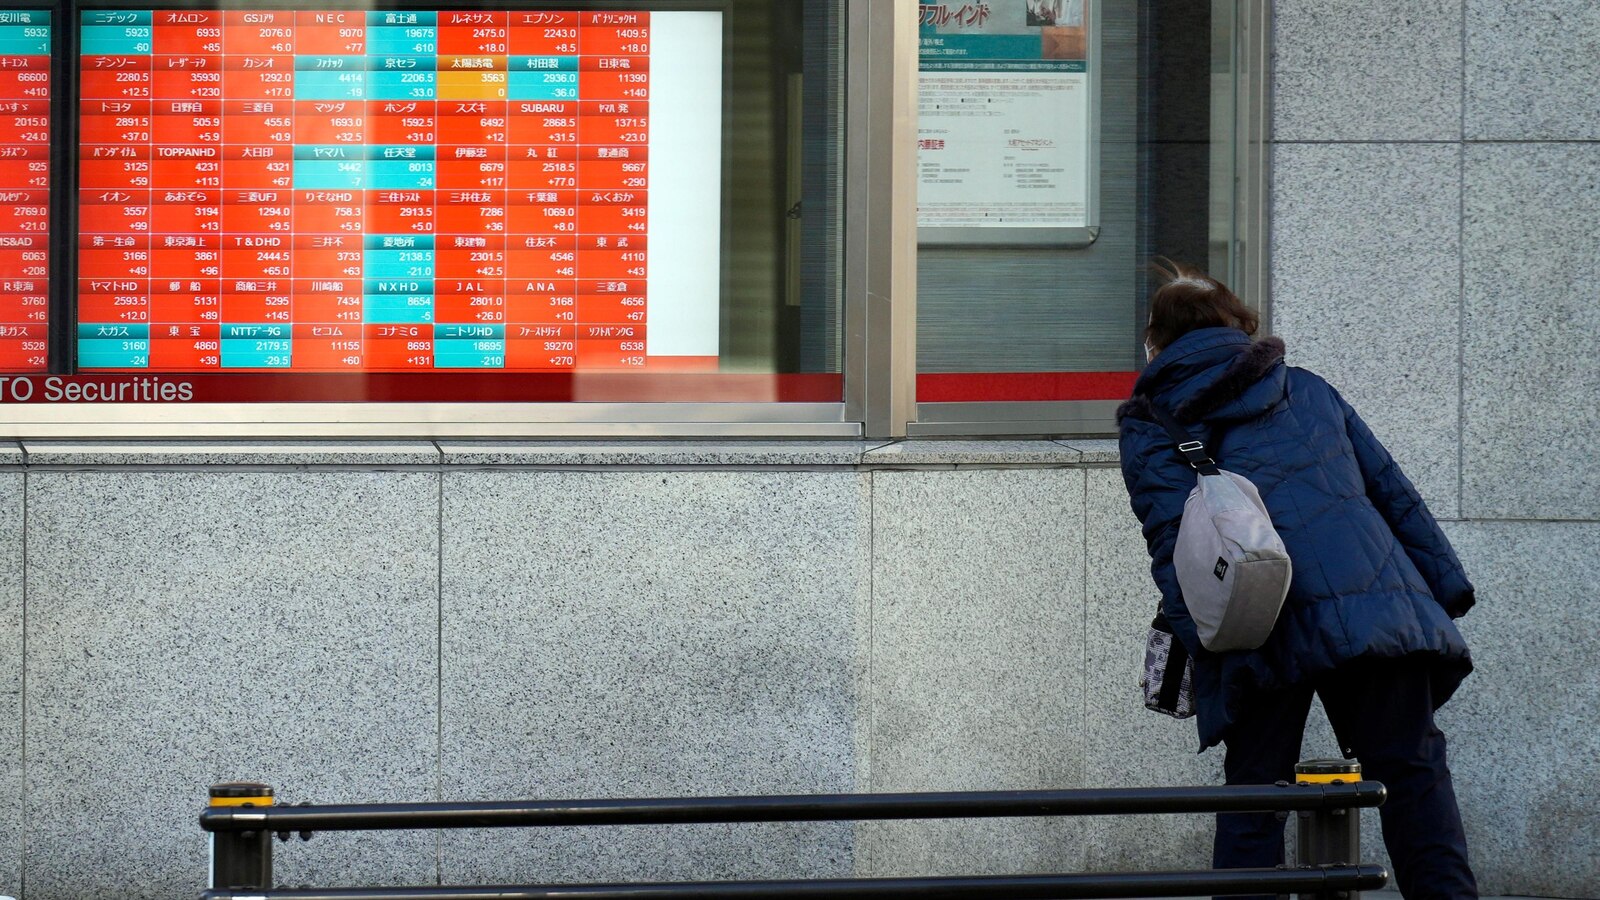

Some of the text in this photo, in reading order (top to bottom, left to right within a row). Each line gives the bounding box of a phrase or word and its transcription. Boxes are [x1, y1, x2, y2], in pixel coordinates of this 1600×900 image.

[95, 12, 138, 23] ニデック
[167, 12, 209, 23] オムロン
[384, 12, 418, 24] 富士通
[451, 13, 494, 24] ルネサス
[522, 12, 565, 24] エプソン
[24, 27, 48, 38] 5932
[125, 27, 150, 38] 5923
[196, 28, 221, 38] 6933
[259, 28, 292, 38] 2076.0
[338, 28, 363, 38] 9070
[404, 28, 435, 38] 19675
[472, 28, 506, 38] 2475.0
[543, 28, 577, 38] 2243.0
[615, 28, 648, 39] 1409.5
[477, 43, 506, 53] +18.0
[620, 43, 648, 53] +18.0
[95, 56, 137, 68] デンソー
[242, 57, 275, 68] カシオ
[384, 58, 417, 69] 京セラ
[450, 57, 494, 69] 太陽誘電
[526, 57, 559, 69] 村田製
[598, 57, 631, 69] 日東電
[17, 72, 48, 82] 66600
[116, 72, 149, 82] 2280.5
[190, 72, 221, 82] 35930
[259, 72, 292, 83] 1292.0
[400, 72, 434, 83] 2206.5
[480, 72, 506, 83] 3563
[542, 72, 577, 83] 2936.0
[618, 73, 647, 83] 11390
[121, 87, 149, 97] +12.5
[190, 87, 221, 97] +1230
[264, 87, 292, 97] +17.0
[407, 87, 434, 97] -33.0
[550, 87, 577, 98] -36.0
[101, 102, 132, 113] トヨタ
[171, 101, 203, 113] 日野自
[241, 102, 274, 113] 三菱自
[314, 102, 346, 113] マツダ
[384, 102, 417, 113] ホンダ
[455, 102, 488, 113] スズキ
[520, 103, 565, 113] SUBARU
[14, 117, 48, 127] 2015.0
[115, 117, 149, 127] 2891.5
[192, 117, 221, 127] 505.9
[263, 117, 292, 127] 455.6
[330, 117, 363, 127] 1693.0
[401, 117, 434, 127] 1592.5
[479, 117, 505, 128] 6492
[542, 117, 576, 128] 2868.5
[614, 118, 647, 128] 1371.5
[19, 132, 48, 142] +24.0
[120, 131, 149, 141] +37.0
[334, 132, 363, 142] +32.5
[405, 132, 434, 142] +31.0
[548, 132, 576, 142] +31.5
[618, 132, 647, 142] +23.0
[157, 147, 216, 157] TOPPANHD
[241, 147, 274, 158] 大日印
[312, 147, 346, 158] ヤマハ
[383, 147, 417, 158] 任天堂
[454, 147, 487, 158] 伊藤忠
[596, 147, 630, 159] 豊通商
[28, 162, 48, 172] 925
[124, 161, 149, 172] 3125
[194, 162, 219, 172] 4231
[265, 162, 290, 172] 4321
[407, 162, 433, 172] 8013
[479, 162, 505, 172] 6679
[542, 162, 576, 172] 2518.5
[622, 162, 647, 172] 9667
[194, 176, 220, 186] +113
[547, 177, 576, 187] +77.0
[98, 191, 131, 202] イオン
[164, 191, 208, 202] あおぞら
[238, 192, 277, 203] 三菱UFJ
[305, 191, 353, 203] りそなHD
[449, 192, 492, 203] 三井住友
[526, 192, 558, 203] 千葉銀
[591, 192, 635, 203] ふくおか
[13, 206, 47, 216] 2769.0
[123, 206, 148, 216] 3557
[194, 206, 219, 216] 3194
[257, 207, 291, 217] 1294.0
[334, 207, 362, 217] 758.3
[399, 207, 433, 217] 2913.5
[479, 207, 504, 217] 7286
[542, 207, 575, 217] 1069.0
[621, 207, 646, 217] 3419
[19, 221, 47, 231] +21.0
[92, 235, 136, 247] 第一生命
[164, 235, 207, 247] 東京海上
[312, 236, 344, 248] 三井不
[383, 236, 415, 248] 菱地所
[453, 236, 486, 248] 東建物
[524, 236, 557, 248] 住友不
[21, 251, 47, 261] 6063
[122, 251, 148, 261] 3166
[194, 251, 218, 261] 3861
[256, 251, 290, 261] 2444.5
[336, 251, 361, 261] 3733
[398, 252, 432, 262] 2138.5
[469, 252, 504, 262] 2301.5
[549, 252, 574, 262] 4546
[620, 252, 646, 262] 4110
[261, 266, 290, 276] +65.0
[475, 266, 503, 276] +42.5
[90, 280, 138, 291] ヤマトHD
[235, 280, 277, 292] 商船三井
[311, 281, 344, 292] 川崎船
[595, 281, 628, 293] 三菱倉
[21, 296, 46, 306] 3760
[113, 296, 147, 306] 2593.5
[193, 296, 217, 306] 5131
[265, 296, 290, 306] 5295
[336, 296, 361, 306] 7434
[406, 296, 432, 306] 8654
[469, 296, 503, 306] 2801.0
[549, 296, 574, 306] 3168
[620, 296, 645, 306] 4656
[119, 311, 147, 321] +12.0
[475, 311, 503, 321] +26.0
[97, 326, 130, 337] 大ガス
[311, 326, 344, 337] セコム
[377, 326, 418, 337] コナミG
[444, 326, 494, 337] ニトリHD
[21, 341, 46, 351] 3528
[122, 341, 147, 351] 3160
[193, 341, 218, 351] 4860
[255, 341, 289, 351] 2179.5
[330, 341, 360, 351] 11155
[407, 341, 431, 351] 8693
[472, 341, 503, 351] 18695
[543, 341, 574, 351] 39270
[619, 341, 645, 351] 6538
[0, 376, 193, 401] TO Securities
